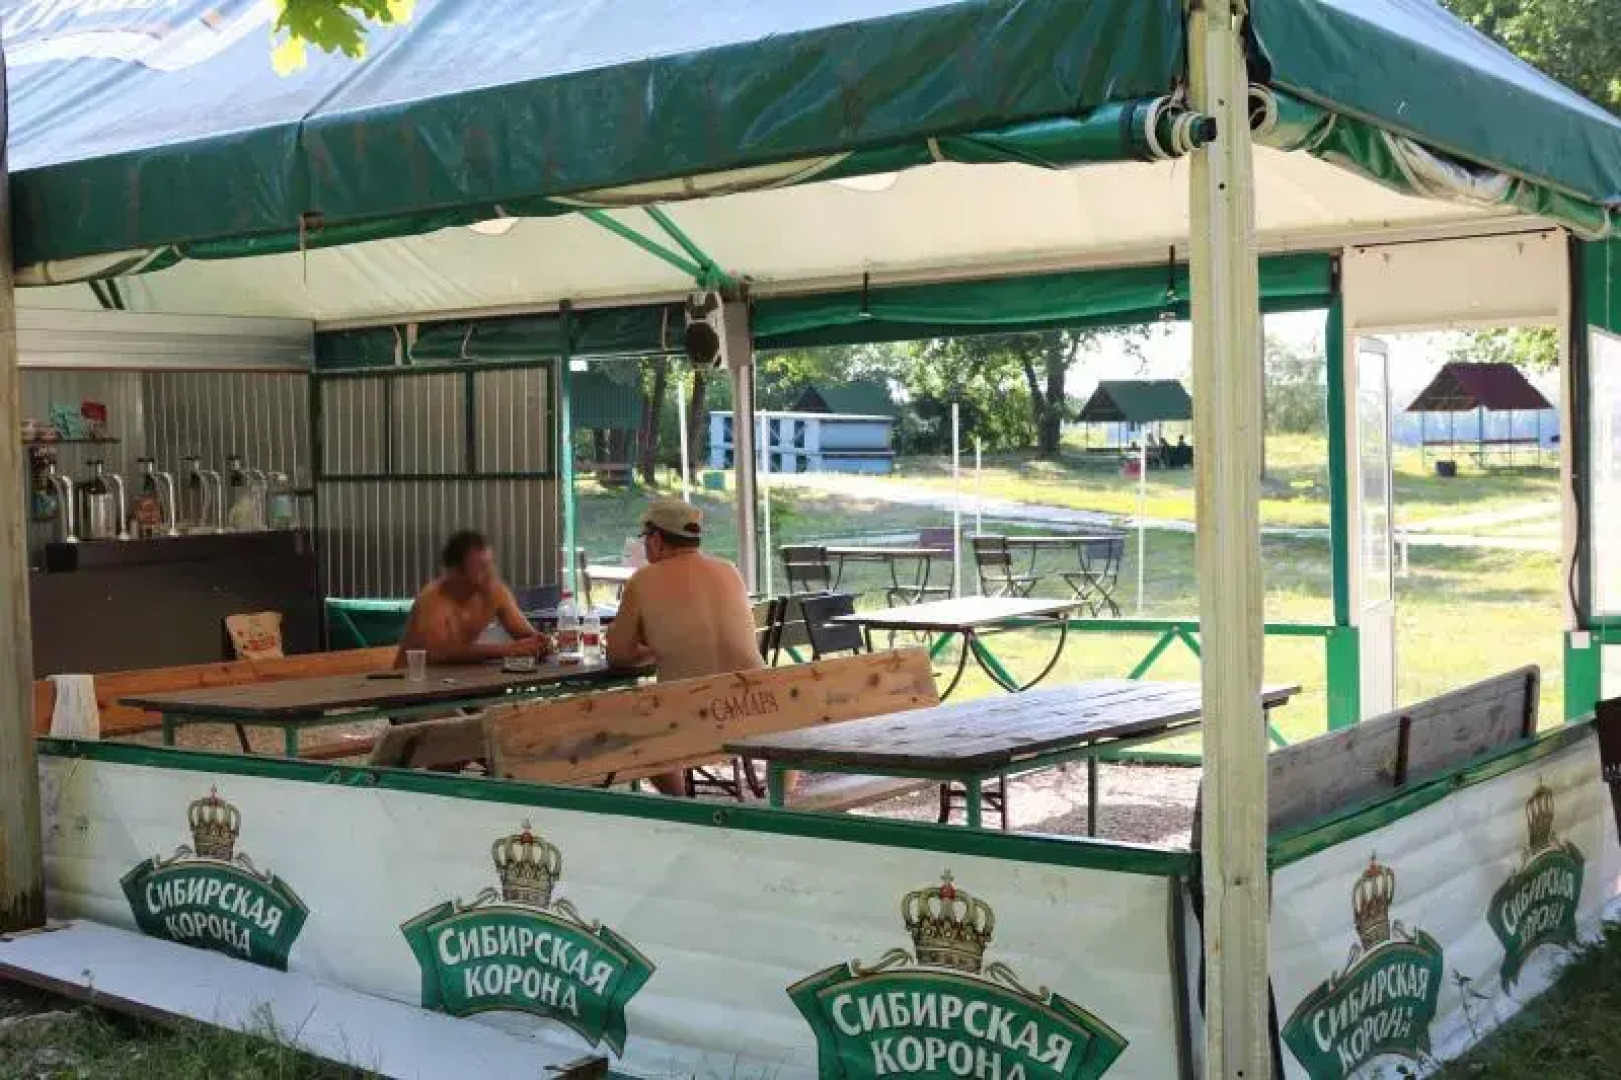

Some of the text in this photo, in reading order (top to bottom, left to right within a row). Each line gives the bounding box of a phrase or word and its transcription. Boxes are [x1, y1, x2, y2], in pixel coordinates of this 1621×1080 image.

[146, 876, 283, 936] СИБИРСКАЯ
[165, 911, 251, 957] КОРОНА
[438, 925, 614, 995] СИБИРСКАЯ
[464, 963, 580, 1016] КОРОНА
[831, 991, 1073, 1072] СИБИРСКАЯ
[1312, 963, 1430, 1052] СИБИРСКАЯ
